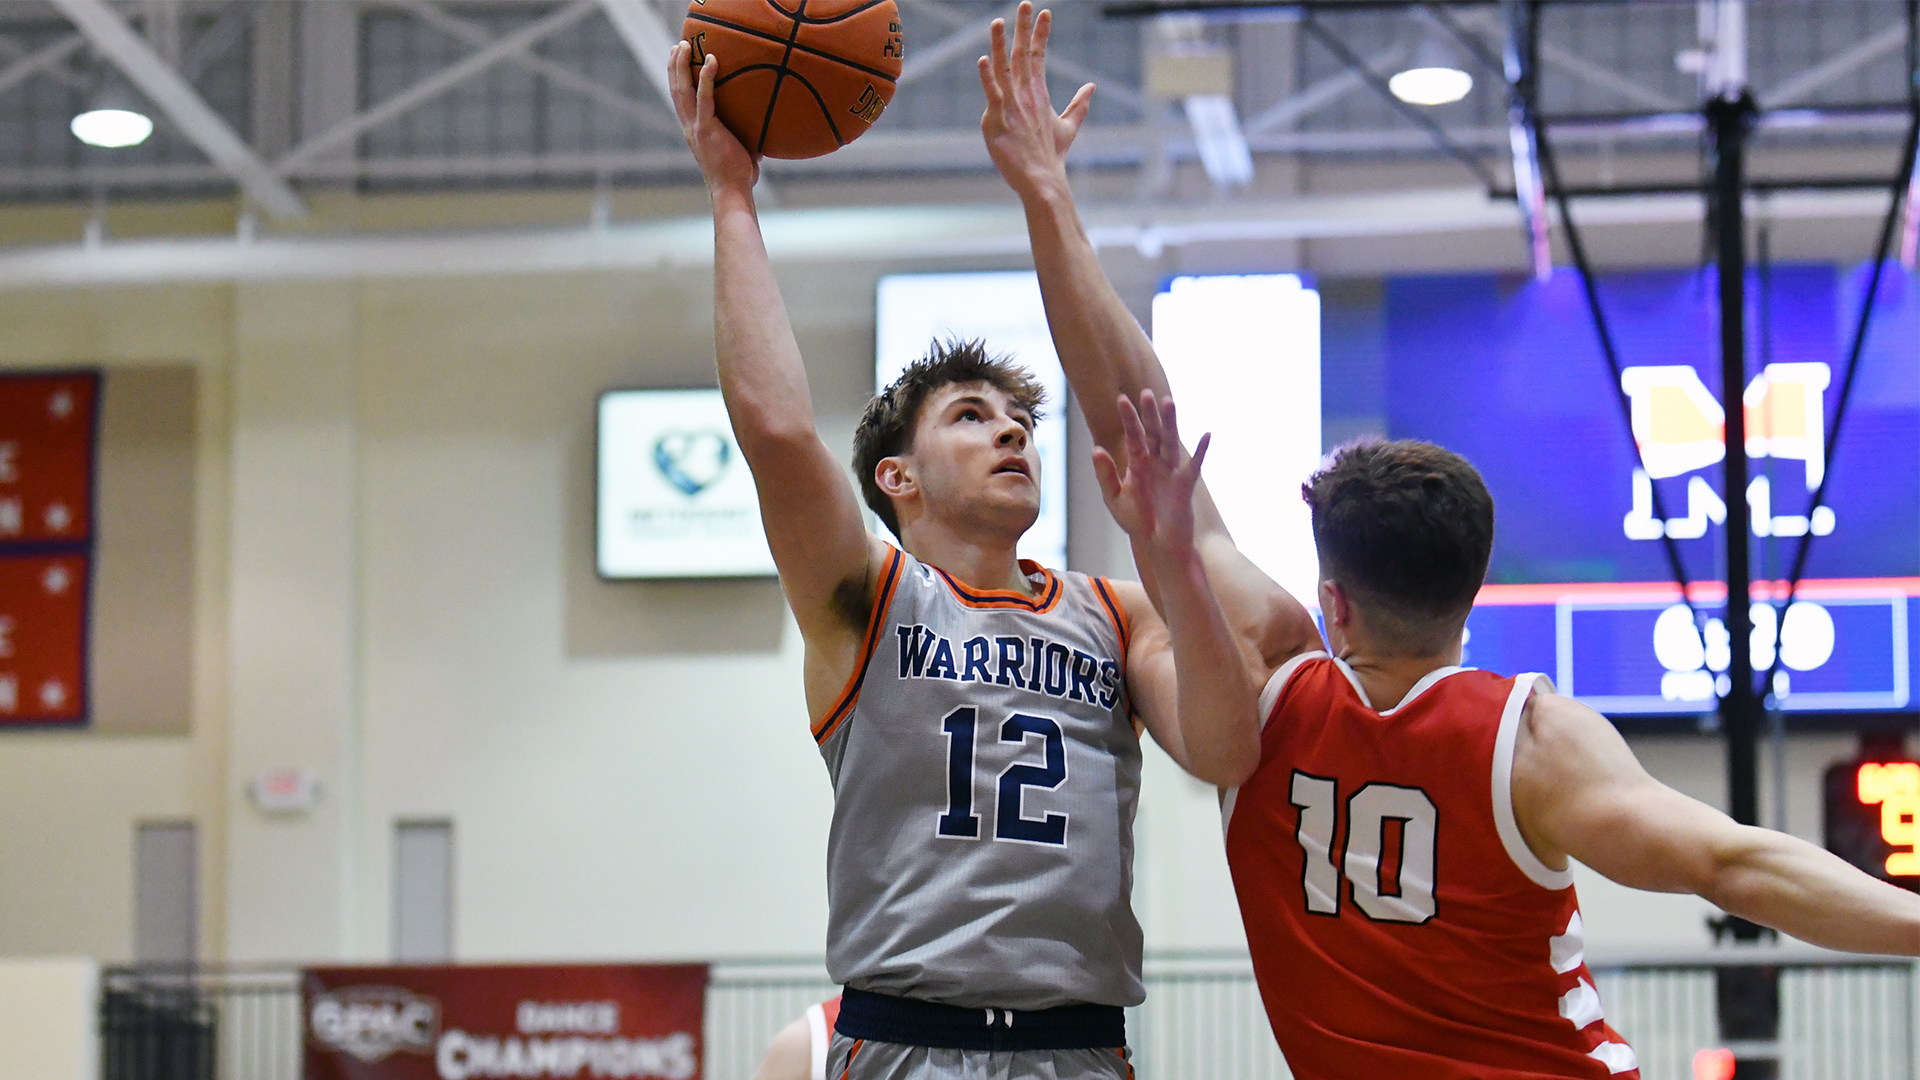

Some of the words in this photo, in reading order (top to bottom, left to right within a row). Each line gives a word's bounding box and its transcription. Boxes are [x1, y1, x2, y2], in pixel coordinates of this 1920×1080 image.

[896, 623, 1121, 712] WARRIORS
[936, 704, 1069, 848] 12
[1288, 767, 1439, 926] 10
[437, 1029, 697, 1080] CHAMPIONS
